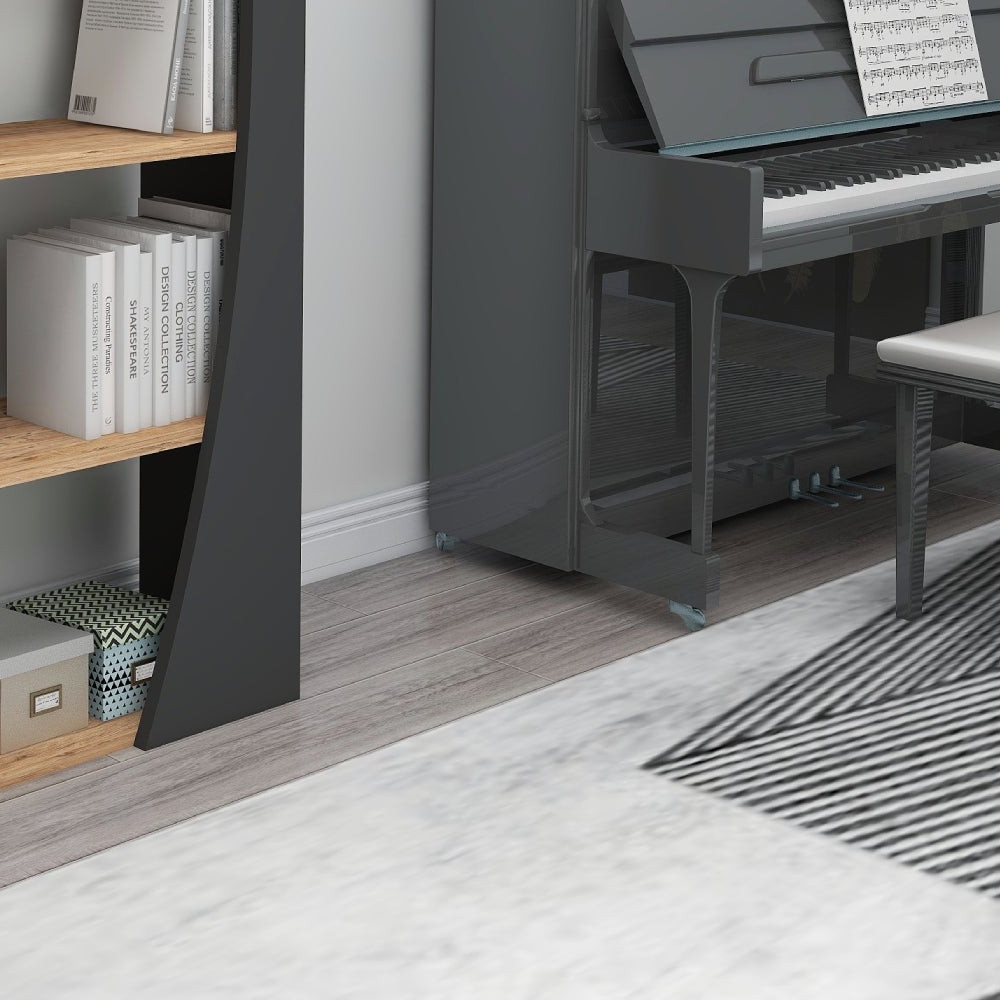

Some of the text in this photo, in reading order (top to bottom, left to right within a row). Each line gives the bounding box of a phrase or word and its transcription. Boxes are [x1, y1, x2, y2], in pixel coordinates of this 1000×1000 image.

[104, 296, 112, 342] Constructing
[129, 300, 138, 379] SHAKESPEARE
[143, 306, 149, 321] MY
[161, 266, 169, 394] DESIGN COLLECTION
[175, 302, 184, 363] CLOTHING
[186, 271, 197, 385] DESIGN COLLECTION
